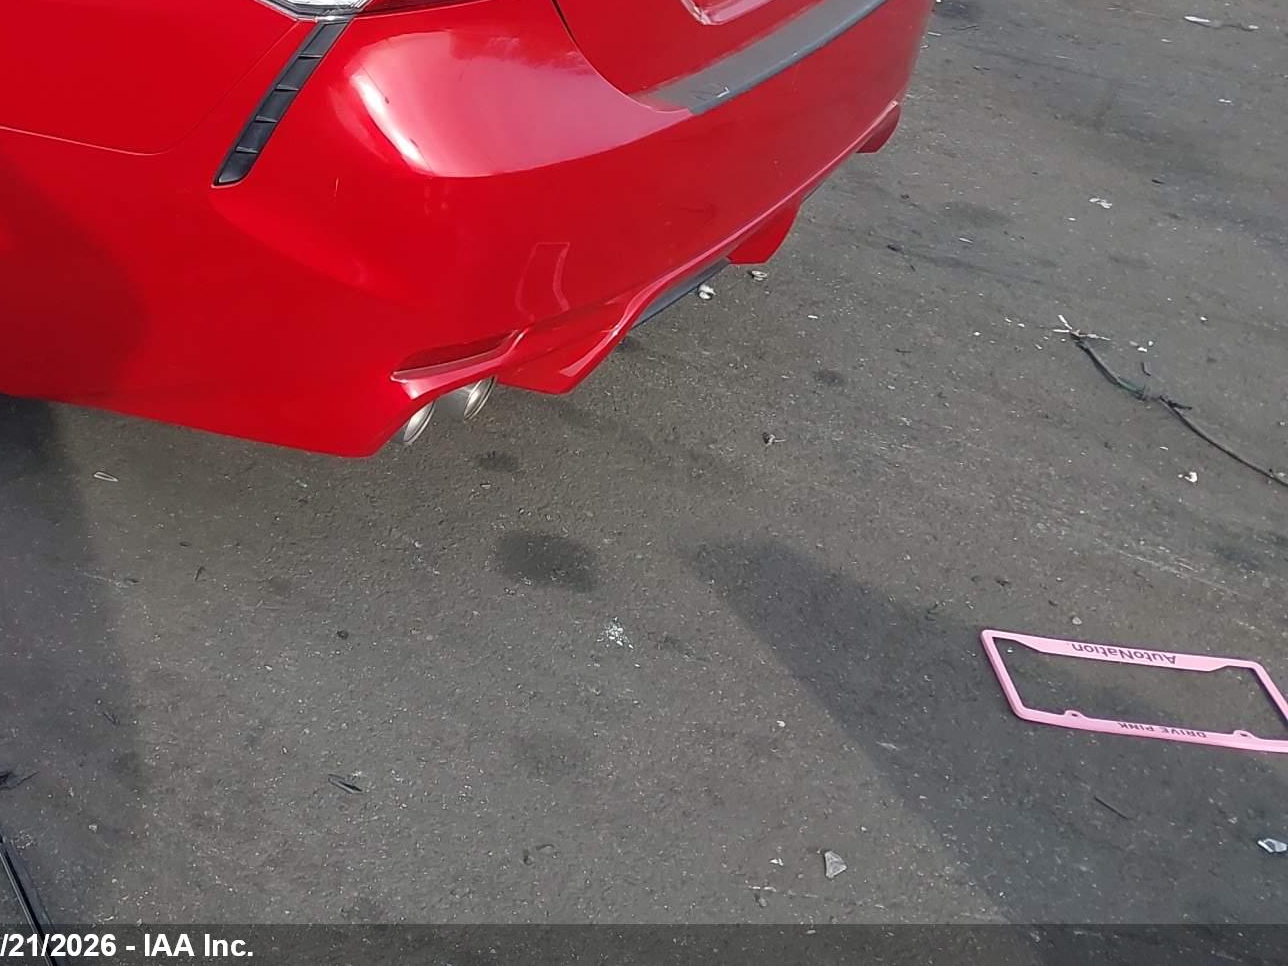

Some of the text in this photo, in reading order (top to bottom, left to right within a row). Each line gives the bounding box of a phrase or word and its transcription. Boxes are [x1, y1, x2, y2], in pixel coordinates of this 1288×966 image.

[1071, 642, 1177, 665] AutoNation
[1117, 721, 1208, 738] DRIVE PINK
